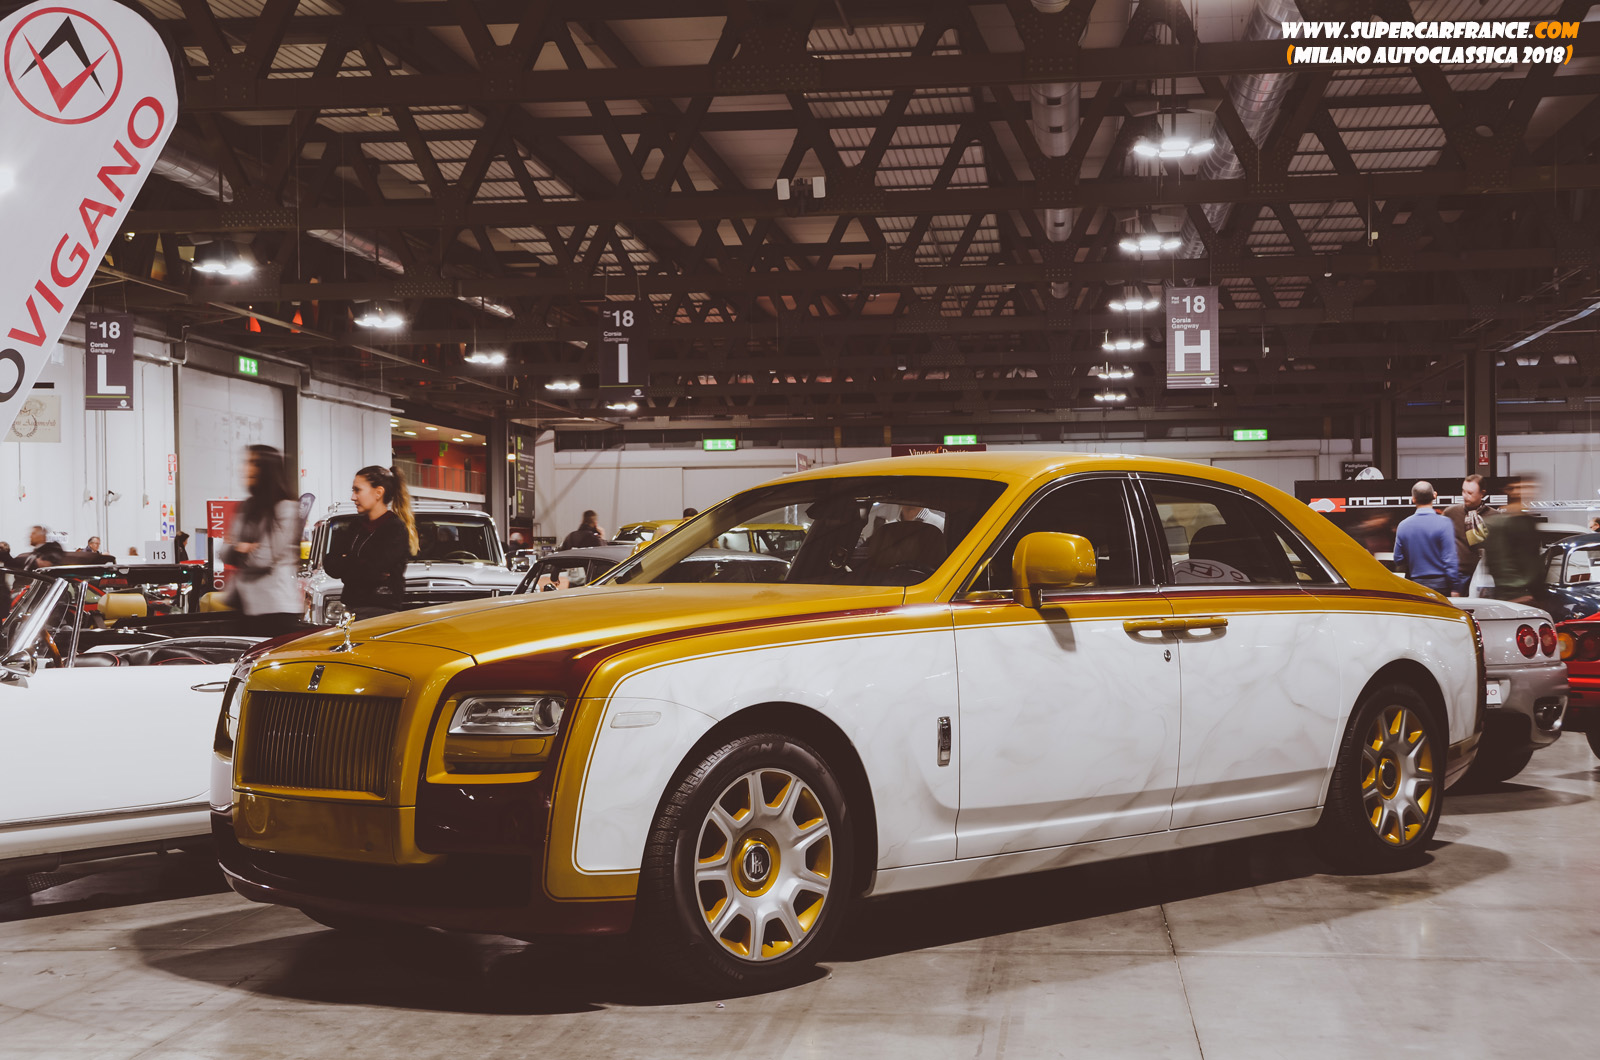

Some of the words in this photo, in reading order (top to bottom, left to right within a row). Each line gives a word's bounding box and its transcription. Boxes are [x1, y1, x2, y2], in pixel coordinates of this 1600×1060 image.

[612, 309, 635, 327] 18
[1182, 295, 1206, 314] 18
[99, 321, 121, 339] 18
[618, 343, 629, 383] I
[1174, 329, 1211, 372] H
[97, 354, 126, 394] L
